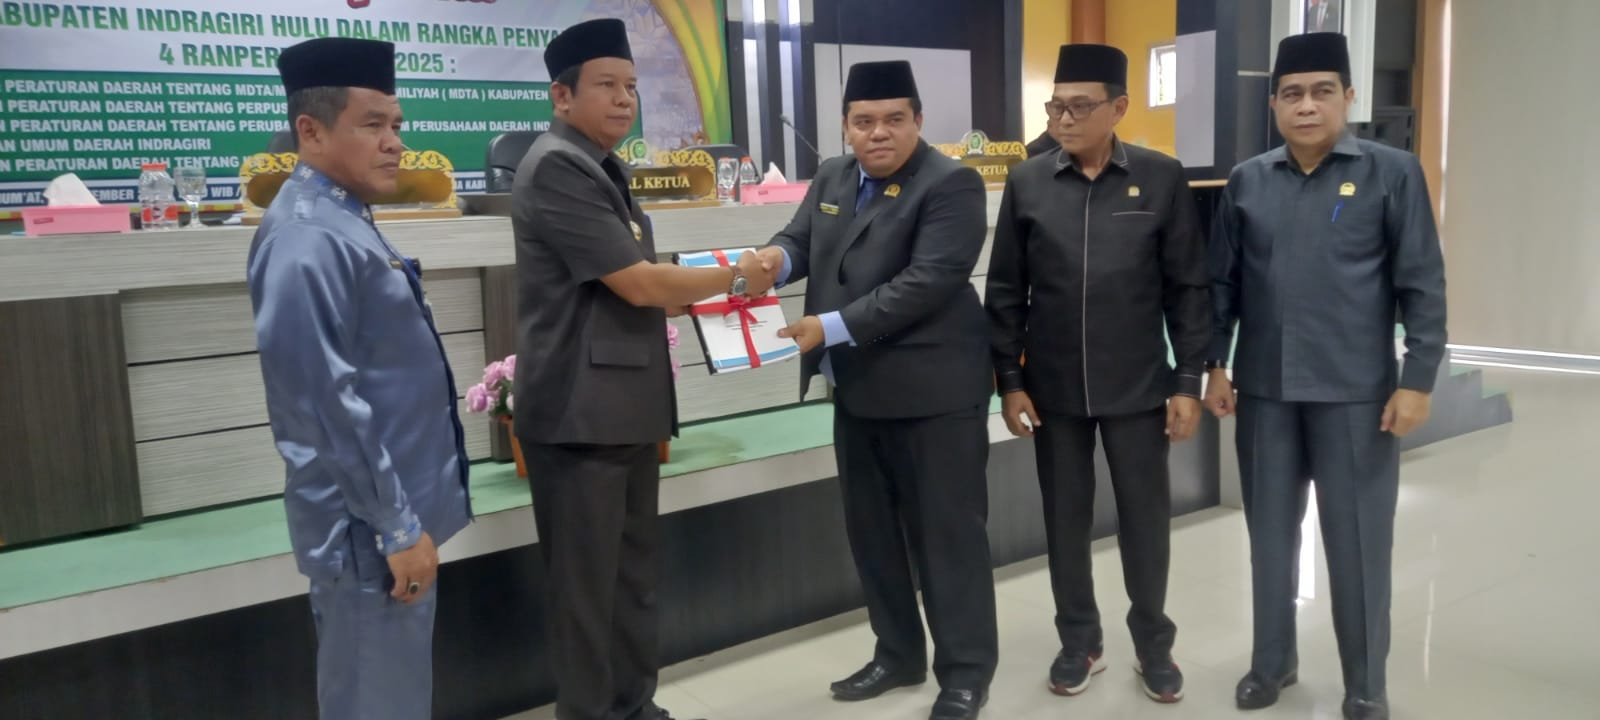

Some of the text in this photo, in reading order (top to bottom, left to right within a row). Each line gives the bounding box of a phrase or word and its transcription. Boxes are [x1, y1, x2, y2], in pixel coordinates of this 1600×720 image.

[0, 1, 129, 30] BUPATEN
[136, 8, 264, 36] INDRAGIRI
[271, 15, 330, 38] HULU
[336, 18, 411, 42] DALAM
[417, 22, 498, 46] RANGKA
[159, 43, 175, 65] 4
[181, 43, 288, 68] RANPER
[394, 52, 444, 73] 2025
[4, 80, 99, 93] PERATURAN
[103, 81, 163, 95] DAERAH
[166, 83, 232, 96] TENTANG
[449, 88, 479, 100] MDTA
[488, 90, 549, 101] KABUPATEN
[8, 100, 101, 113] PERATURAN
[105, 101, 164, 113] DAERAH
[168, 101, 234, 114] TENTANG
[10, 119, 103, 132] PERATURAN
[107, 119, 167, 132] DAERAH
[170, 120, 236, 132] TENTANG
[412, 121, 486, 131] PERUSAHAAN
[490, 121, 530, 132] DAERAH
[20, 140, 69, 152] UMUM
[73, 139, 134, 151] DAERAH
[138, 138, 211, 150] INDRAGIRI
[15, 158, 108, 171] PERATURAN
[174, 156, 239, 168] TENTANG
[643, 175, 690, 189] KETUA
[211, 186, 233, 198] WIB
